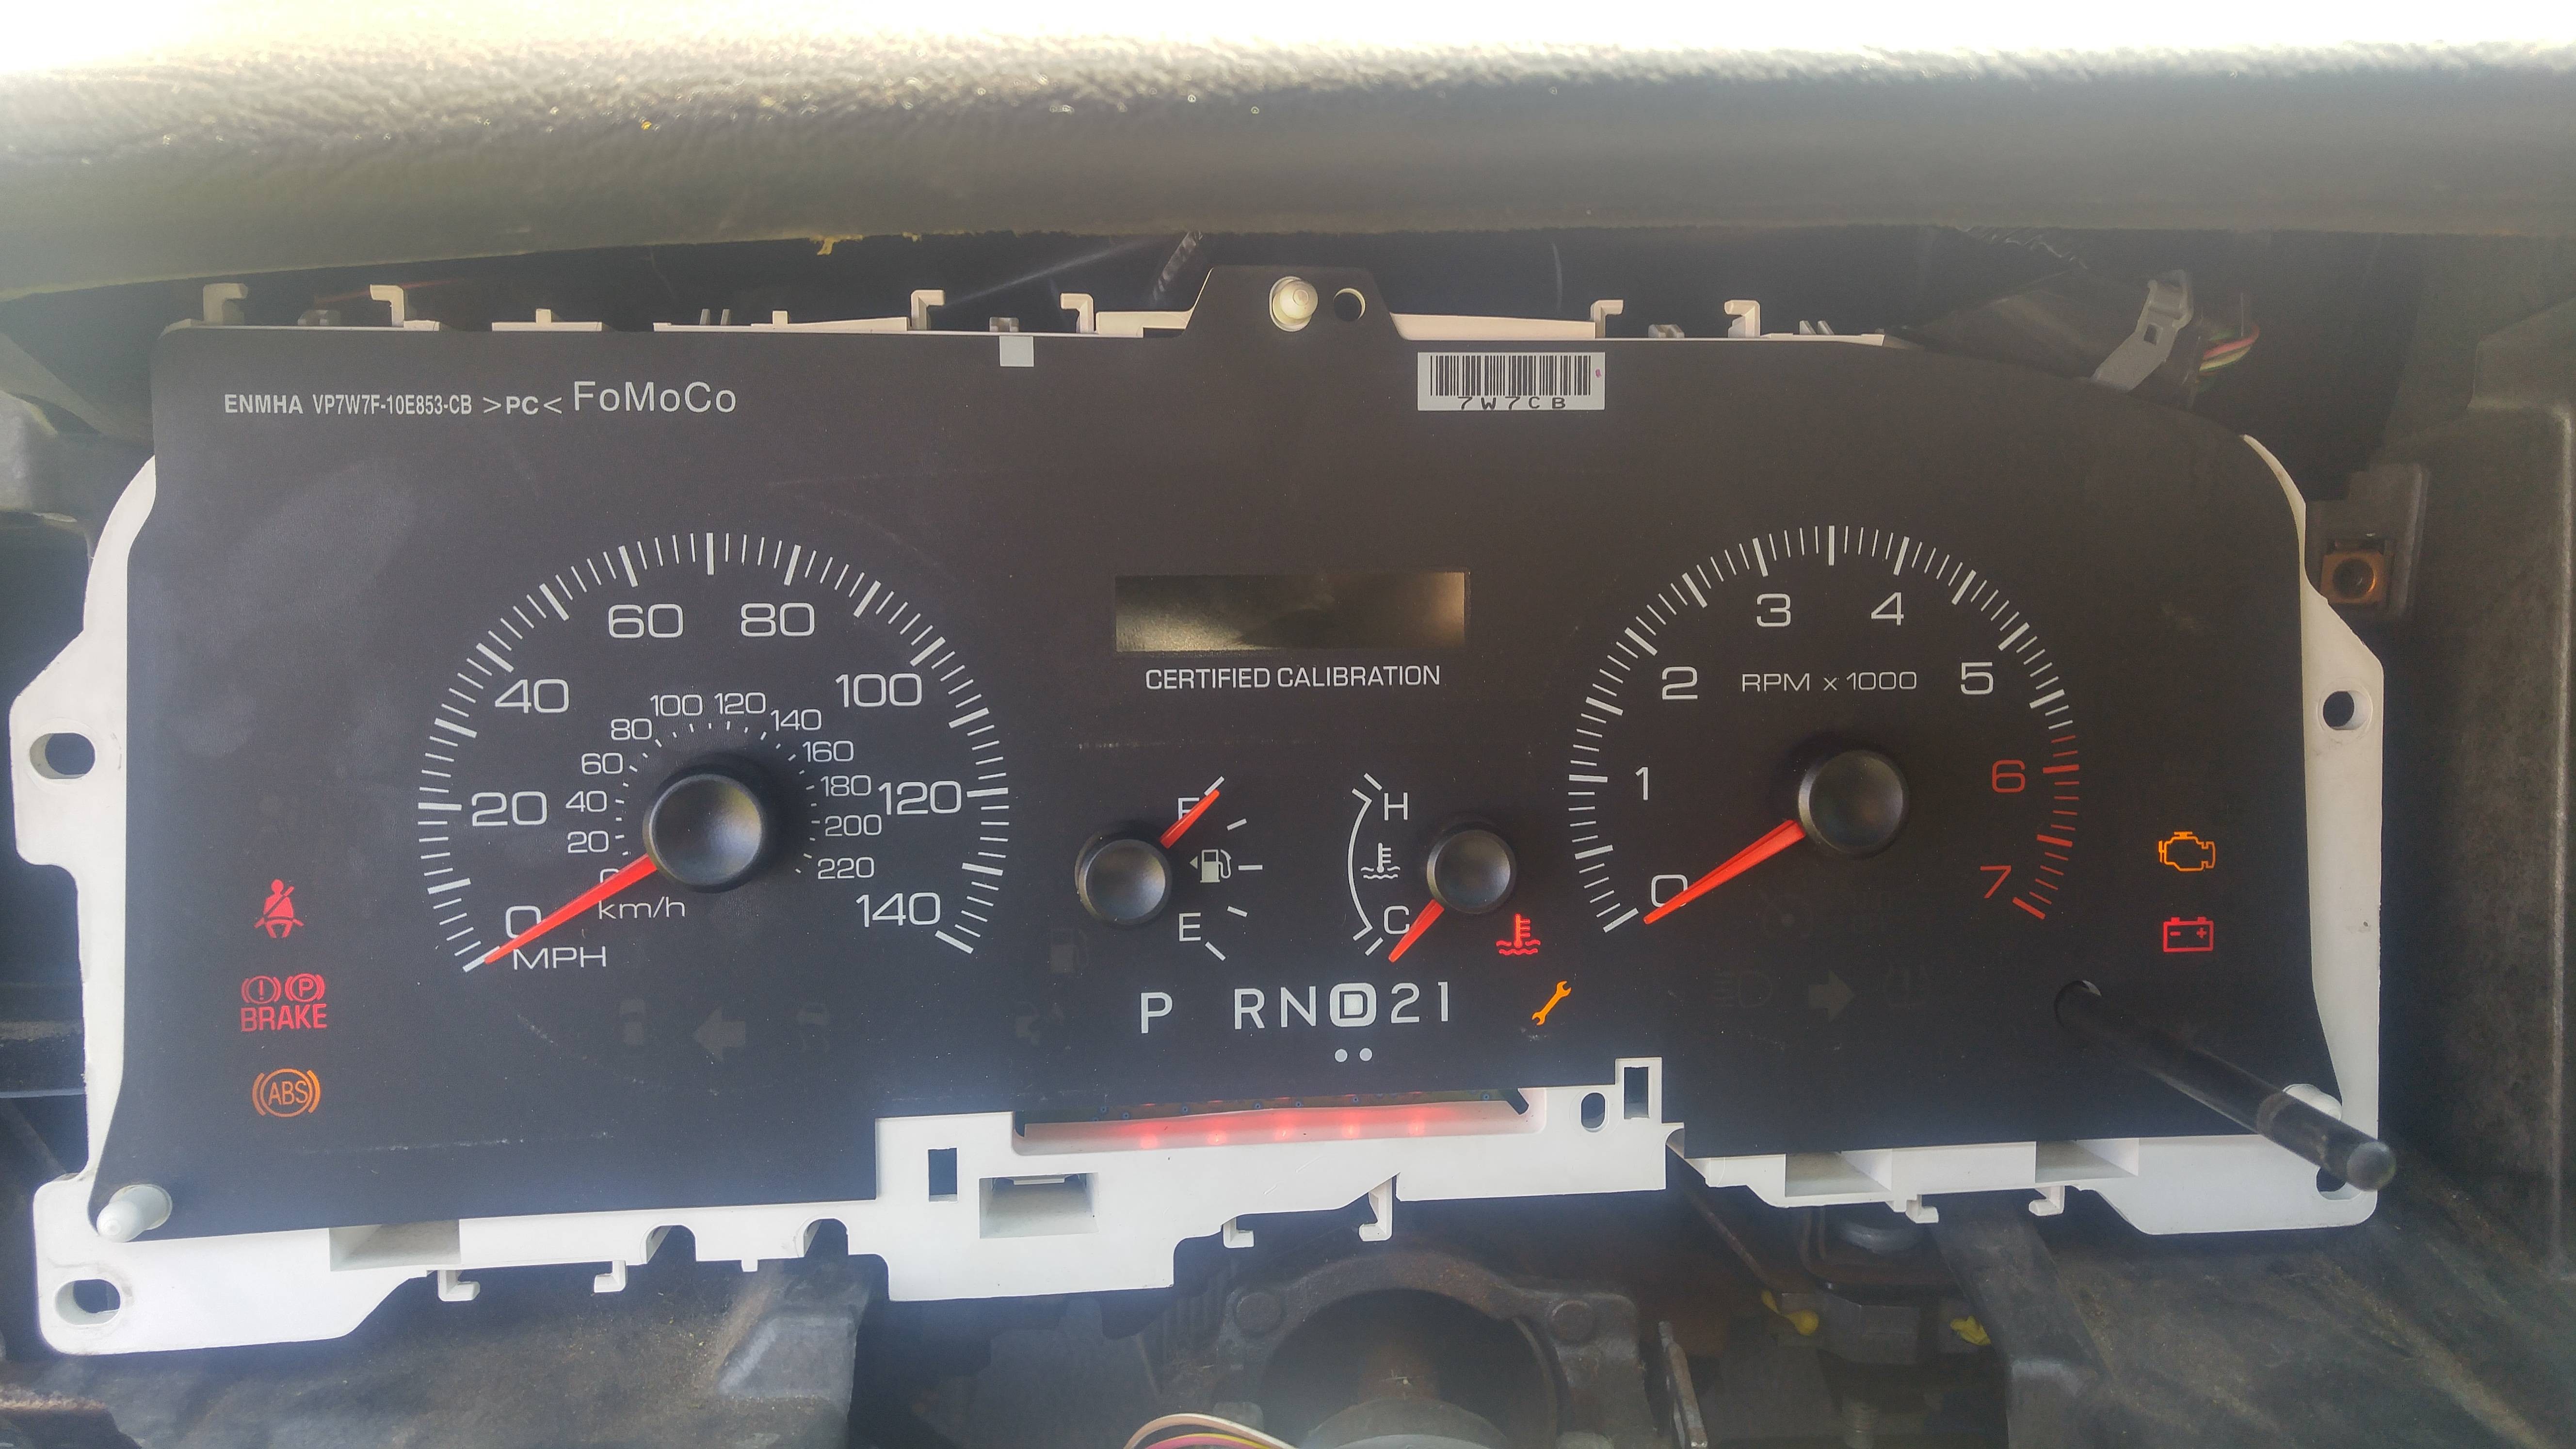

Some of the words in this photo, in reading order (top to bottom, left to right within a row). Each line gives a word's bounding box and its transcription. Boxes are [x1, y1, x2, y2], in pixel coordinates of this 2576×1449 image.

[225, 394, 304, 414] ENMHA
[312, 394, 472, 415] VP7W7F-10E853-CB
[574, 381, 736, 413] FoMoCo
[608, 604, 683, 638] 60
[741, 603, 815, 637] 80
[1756, 593, 1791, 627] 3
[1871, 592, 1904, 626] 4
[835, 673, 922, 708] 100
[1145, 668, 1270, 690] CERTIFIED
[1277, 665, 1440, 687] CALIBRATION
[1662, 666, 1698, 700] 2
[1742, 673, 1810, 692] RPM
[1846, 671, 1917, 690] 1000
[1961, 662, 1994, 695] 5
[495, 679, 569, 713] 40
[650, 694, 703, 717] 100
[714, 692, 766, 715] 120
[611, 718, 652, 741] 80
[772, 708, 822, 731] 140
[581, 753, 623, 775] 60
[802, 741, 854, 762] 160
[821, 774, 871, 797] 180
[1635, 767, 1648, 801] 1
[1992, 759, 2026, 793] 6
[471, 791, 547, 827] 20
[565, 790, 607, 812] 40
[878, 781, 962, 816] 120
[1384, 792, 1408, 821] H
[825, 814, 882, 837] 200
[567, 830, 609, 853] 20
[818, 856, 874, 880] 220
[1980, 865, 2012, 899] 7
[1650, 874, 1689, 908] 0
[505, 905, 542, 939] 0
[598, 896, 686, 920] km/h
[856, 892, 941, 928] 140
[1384, 905, 1410, 935] C
[1179, 912, 1201, 942] E
[513, 945, 607, 970] MPH
[240, 1003, 327, 1032] BRAKE
[1141, 992, 1173, 1034] P
[267, 1080, 309, 1107] ABS
